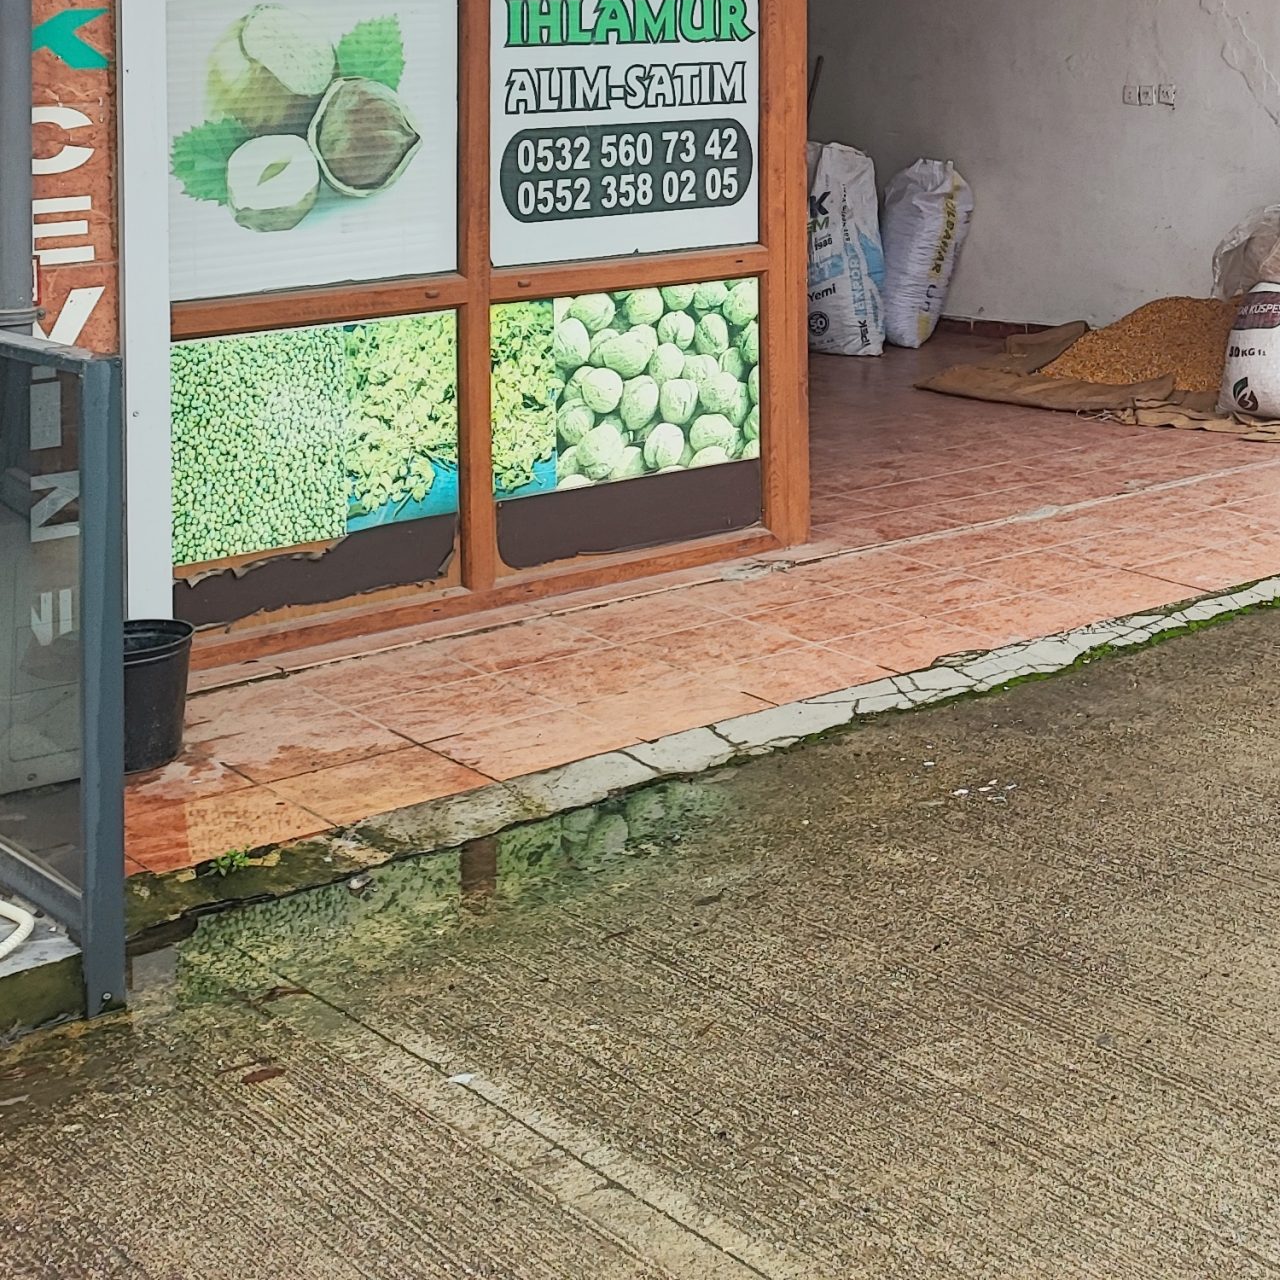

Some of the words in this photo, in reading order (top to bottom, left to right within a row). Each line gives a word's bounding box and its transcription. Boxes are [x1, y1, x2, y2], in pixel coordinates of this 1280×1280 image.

[504, 61, 747, 115] ALIM-SATIM
[517, 136, 591, 174] 0532
[600, 133, 653, 168] 560
[662, 130, 696, 164] 73
[704, 127, 738, 161] 42
[517, 177, 591, 215] 0552
[600, 173, 653, 209] 358
[662, 170, 696, 204] 02
[705, 167, 738, 200] 05
